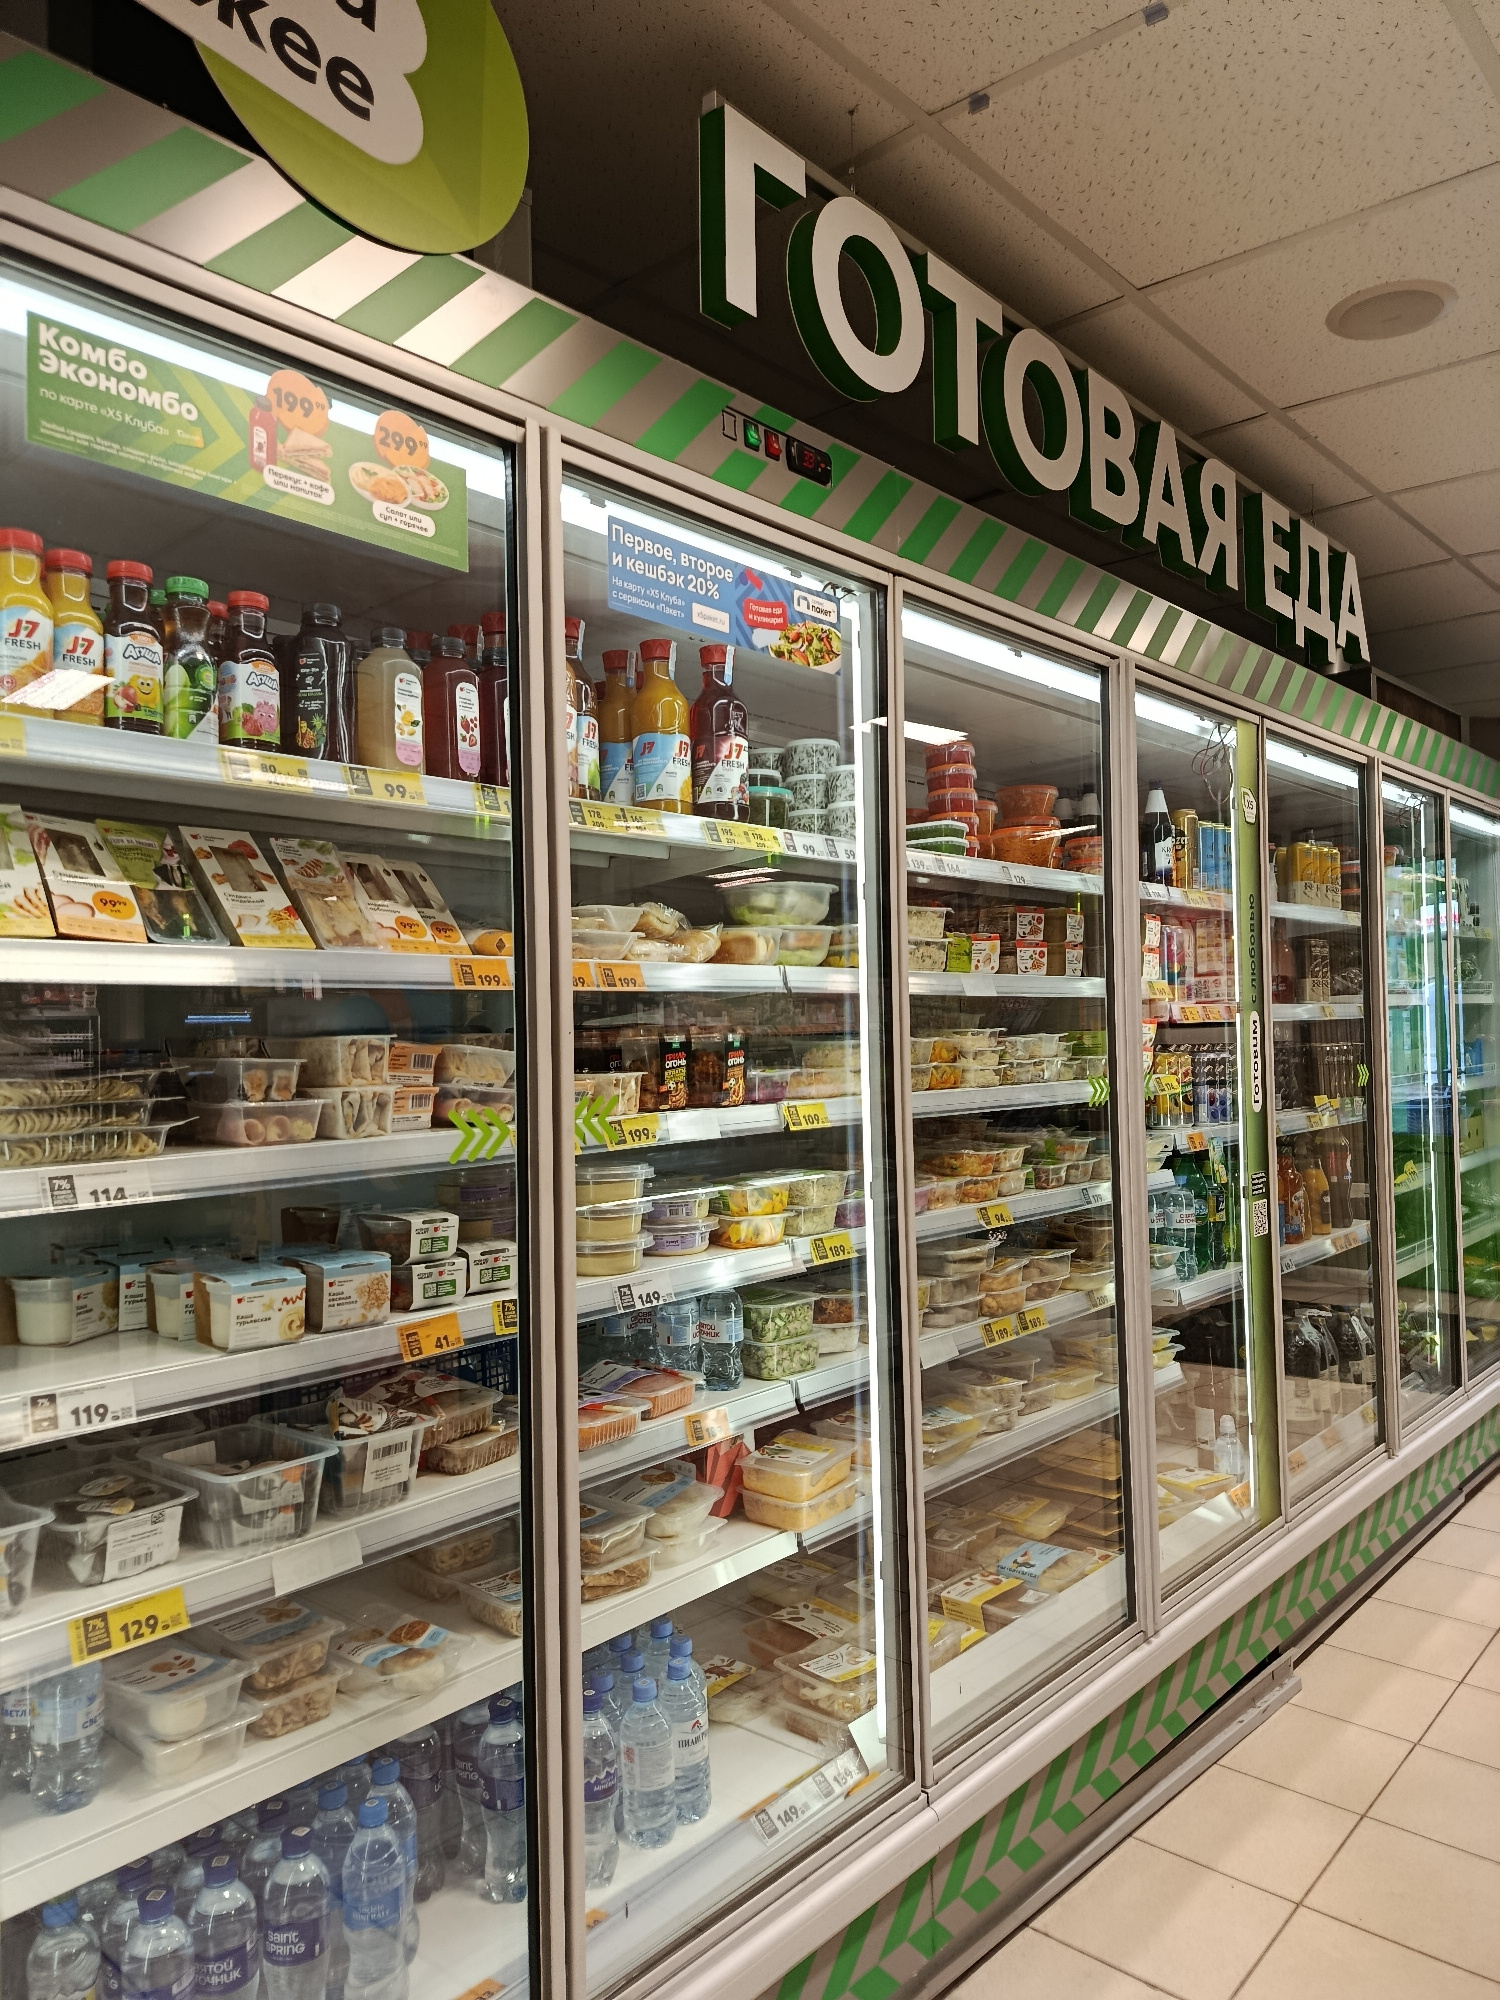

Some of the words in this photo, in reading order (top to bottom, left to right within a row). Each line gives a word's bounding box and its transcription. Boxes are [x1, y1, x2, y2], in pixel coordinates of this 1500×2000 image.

[38, 322, 148, 380] Комбо
[38, 348, 199, 422] Экономбо
[724, 103, 1239, 591] ГОТОВАЯ
[1261, 491, 1371, 663] ЕДА
[272, 386, 315, 419] 199
[39, 387, 58, 401] по
[59, 394, 98, 415] карте
[124, 414, 170, 438] Клуба»
[378, 425, 418, 457] 299
[268, 467, 301, 487] Перекус
[309, 481, 330, 496] кофе
[272, 478, 289, 490] или
[379, 512, 393, 523] суп
[399, 519, 429, 534] горячее
[385, 506, 408, 519] Салат
[408, 515, 423, 524] или
[611, 523, 677, 566] Первое,
[680, 552, 735, 584] второе
[611, 551, 623, 568] и
[626, 556, 685, 589] кешбэк
[687, 574, 720, 600] 20%
[611, 575, 623, 588] На
[623, 580, 645, 595] карту
[660, 591, 686, 607] Клуба»
[612, 590, 618, 598] с
[618, 591, 655, 610] сервисом
[656, 603, 685, 618] «Пакет»
[749, 602, 772, 615] Готовая
[772, 606, 783, 614] еда
[8, 618, 41, 639] J7
[753, 614, 784, 626] кулинария
[4, 637, 41, 651] FRESH
[66, 636, 95, 656] J7
[62, 653, 96, 668] FRESH
[584, 720, 597, 740] J7
[674, 740, 689, 758] J7
[723, 742, 744, 760] J7
[721, 759, 745, 770] FRESH
[384, 782, 407, 798] 99
[802, 843, 816, 855] 99
[99, 897, 117, 910] 99
[477, 974, 501, 987] 199
[618, 977, 637, 988] 199
[665, 1051, 687, 1062] ГРИЛЬ
[727, 1056, 745, 1067] ОГОНЬ
[728, 1049, 745, 1059] ГРИЛЬ
[665, 1057, 687, 1070] ОГОНЬ
[802, 1113, 820, 1126] 109
[627, 1127, 651, 1143] 199
[52, 1178, 71, 1191] 7%
[89, 1186, 129, 1204] 114
[994, 1213, 1006, 1223] 94
[828, 1244, 847, 1258] 189
[637, 1290, 661, 1307] 149
[434, 1334, 451, 1350] 41
[995, 1327, 1009, 1341] 189
[70, 1403, 109, 1427] 119
[86, 1616, 106, 1633] 7%
[119, 1614, 159, 1644] 129
[776, 1804, 801, 1828] 149
